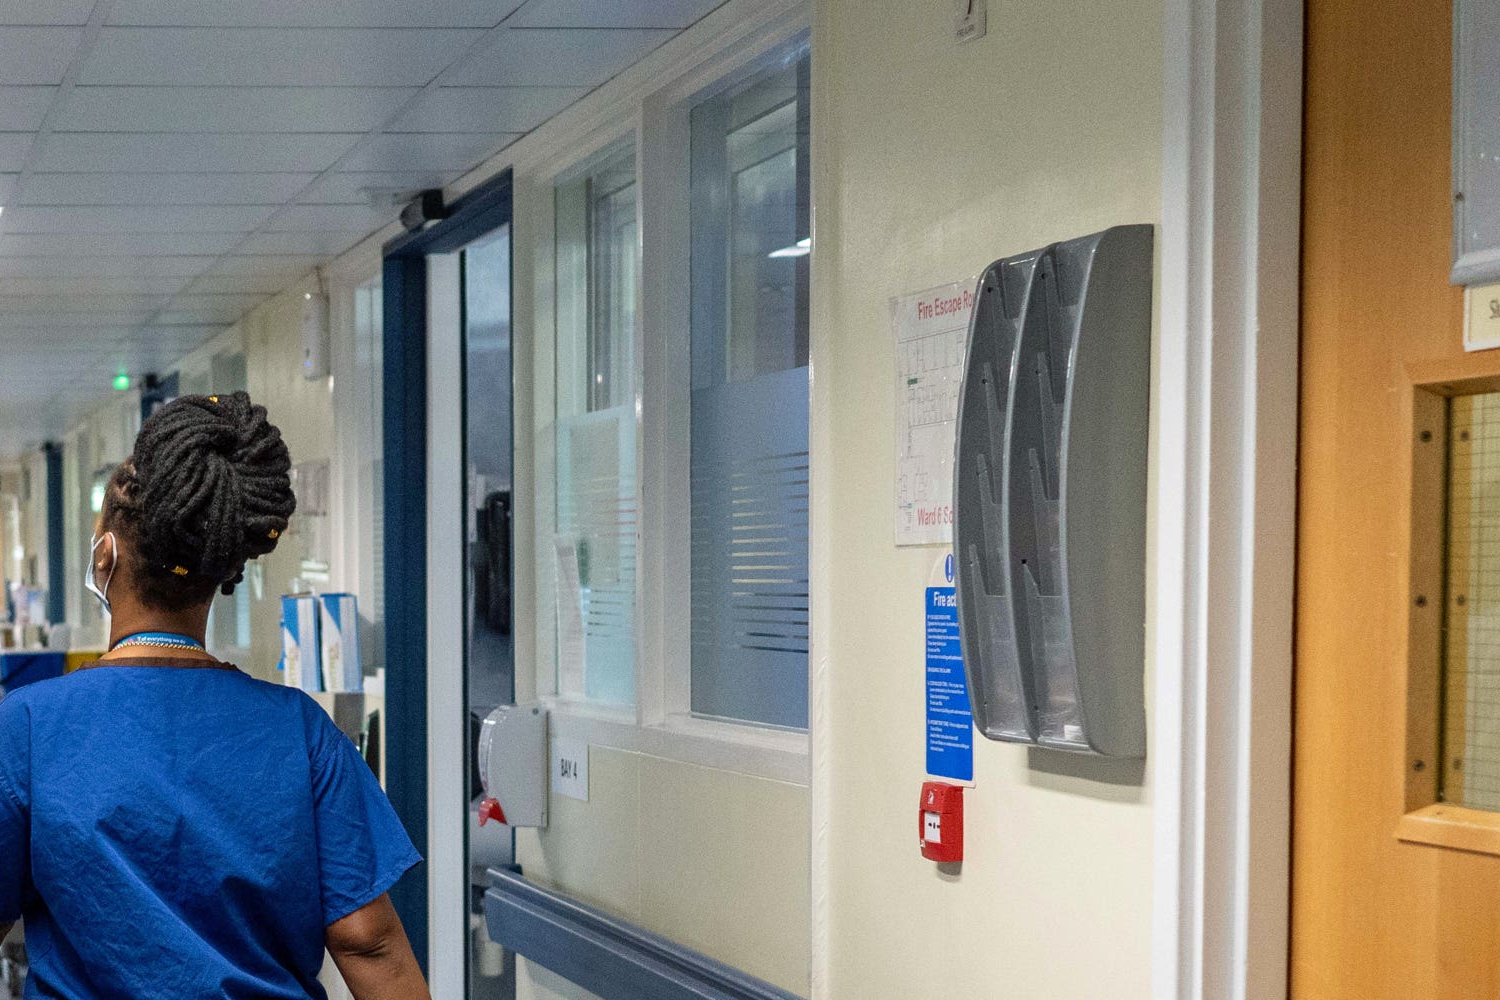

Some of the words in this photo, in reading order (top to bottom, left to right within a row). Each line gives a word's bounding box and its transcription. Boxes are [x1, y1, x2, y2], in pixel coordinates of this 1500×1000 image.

[918, 301, 933, 320] Fire
[934, 297, 962, 317] Escape
[917, 507, 936, 526] Ward
[933, 591, 946, 607] Fire
